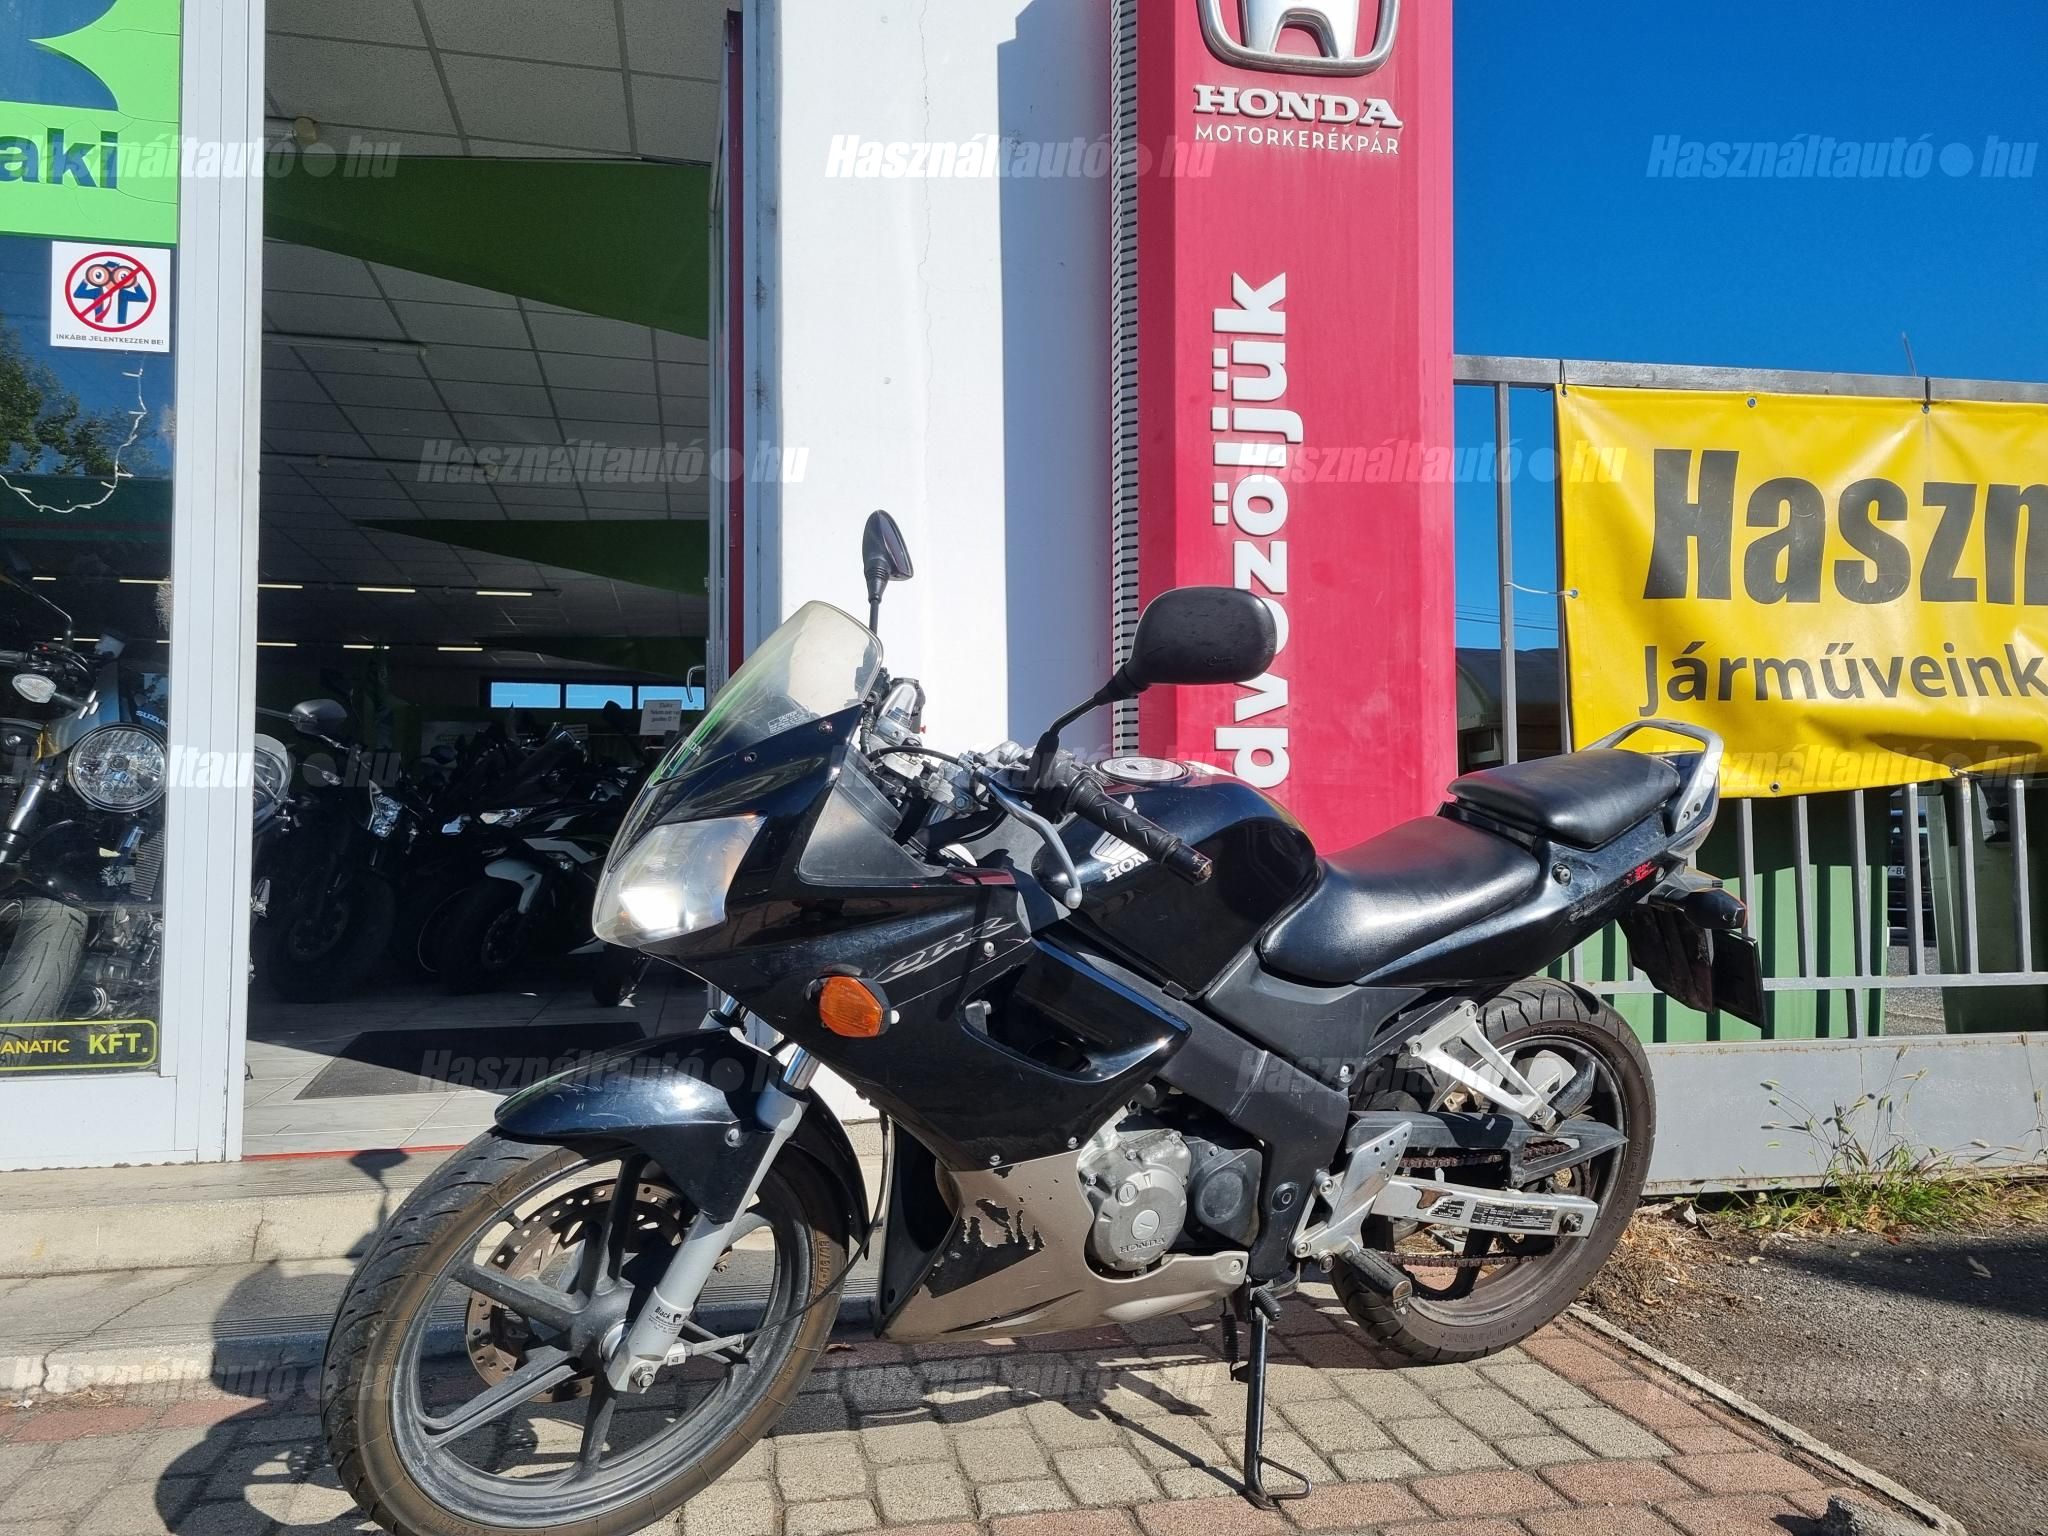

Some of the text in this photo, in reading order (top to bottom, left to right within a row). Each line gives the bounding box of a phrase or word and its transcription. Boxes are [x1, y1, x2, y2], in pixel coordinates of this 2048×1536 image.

[1194, 84, 1403, 128] HONDA
[1195, 123, 1399, 154] MOTORKERÉKPÁR
[0, 127, 118, 189] aki
[56, 333, 87, 341] INKÁBB
[89, 335, 150, 345] JELENTKEZZEN
[1643, 449, 2048, 606] Haszn
[1639, 641, 2048, 717] Járműveink
[89, 1032, 148, 1055] KFT.
[1119, 1237, 1165, 1254] HONDA
